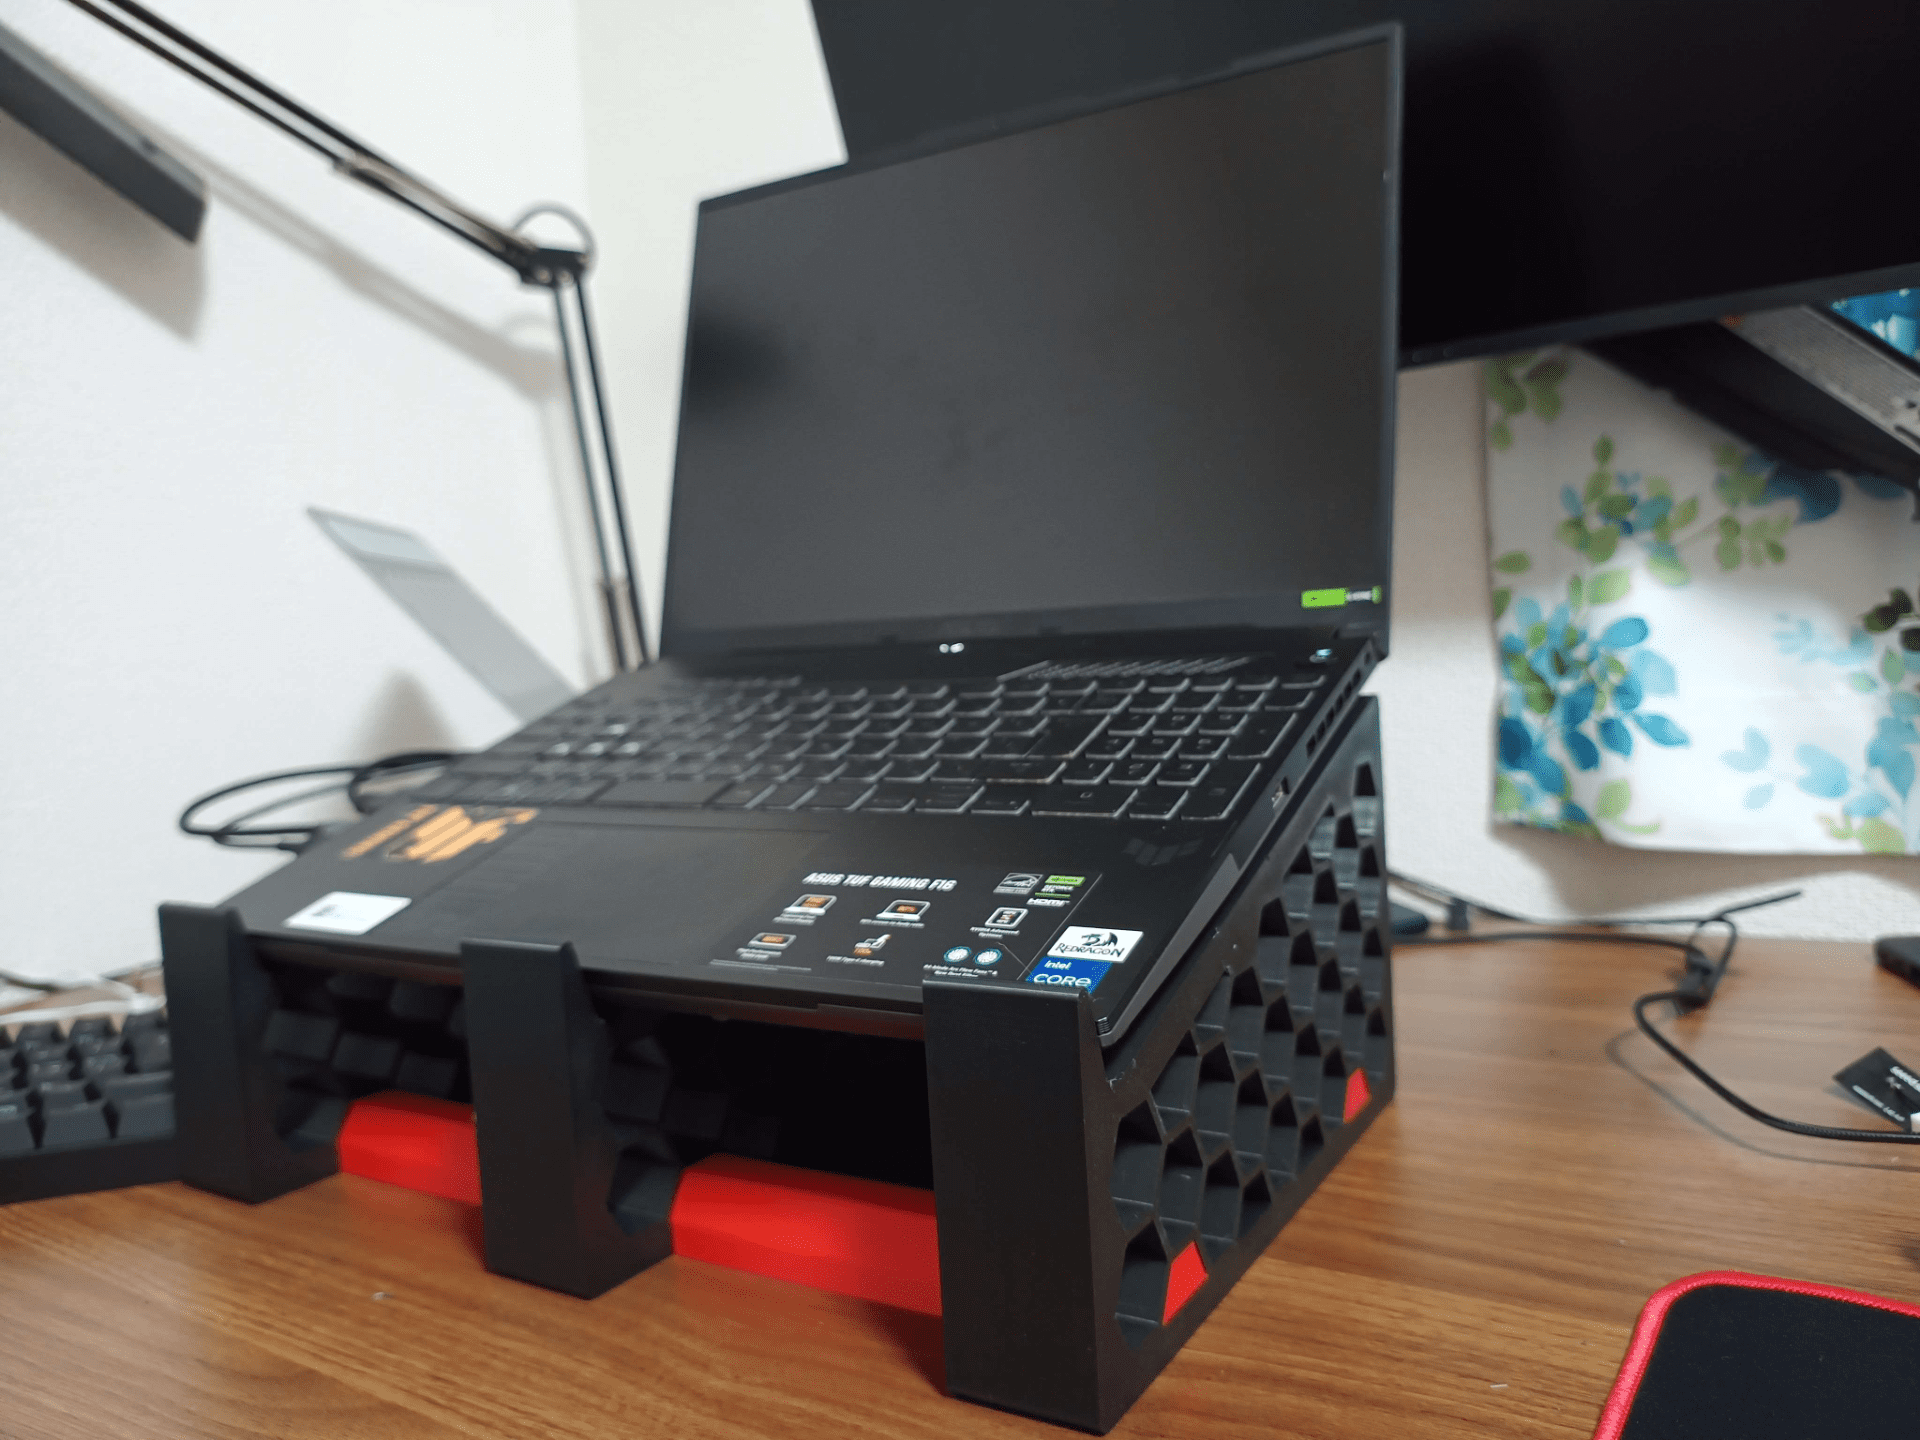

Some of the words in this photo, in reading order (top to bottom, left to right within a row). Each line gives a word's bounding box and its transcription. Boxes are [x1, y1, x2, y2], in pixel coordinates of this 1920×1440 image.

[802, 872, 845, 886] ASUS
[842, 874, 873, 887] TUF
[869, 876, 931, 890] GAMING
[928, 879, 958, 891] F16
[1055, 943, 1125, 957] REDRAGON
